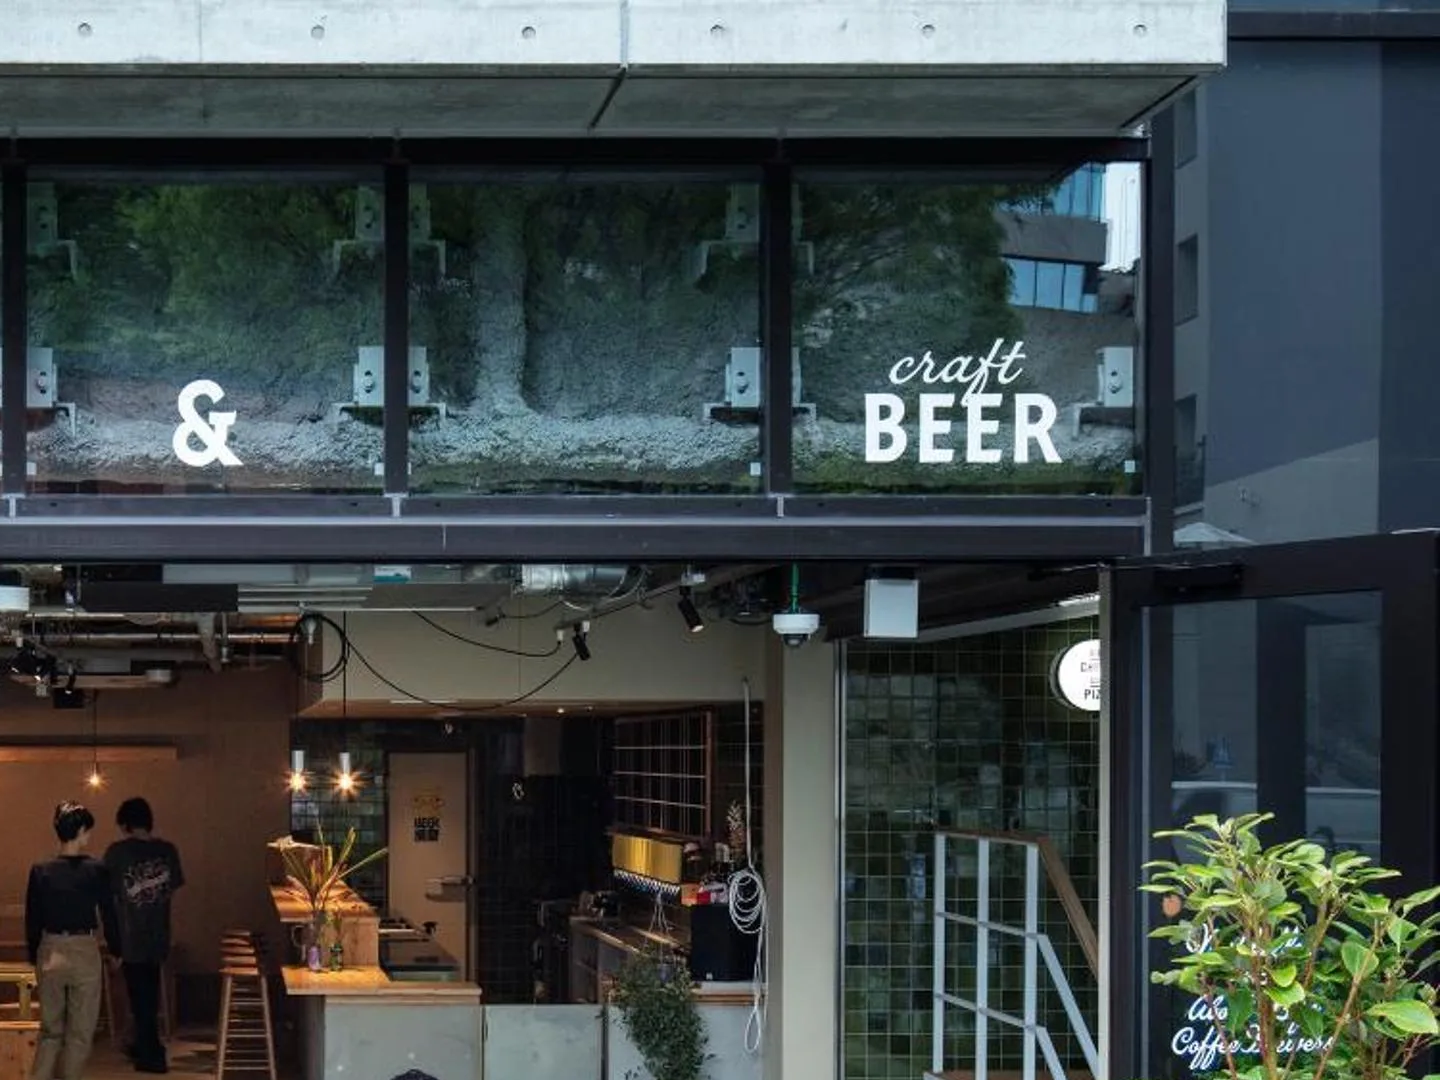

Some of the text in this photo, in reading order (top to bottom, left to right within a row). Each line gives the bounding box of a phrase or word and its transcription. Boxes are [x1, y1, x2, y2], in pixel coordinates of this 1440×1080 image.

[888, 337, 1026, 406] craft
[172, 379, 244, 467] &
[864, 392, 1063, 463] BEER
[1171, 1025, 1241, 1070] Coffee
